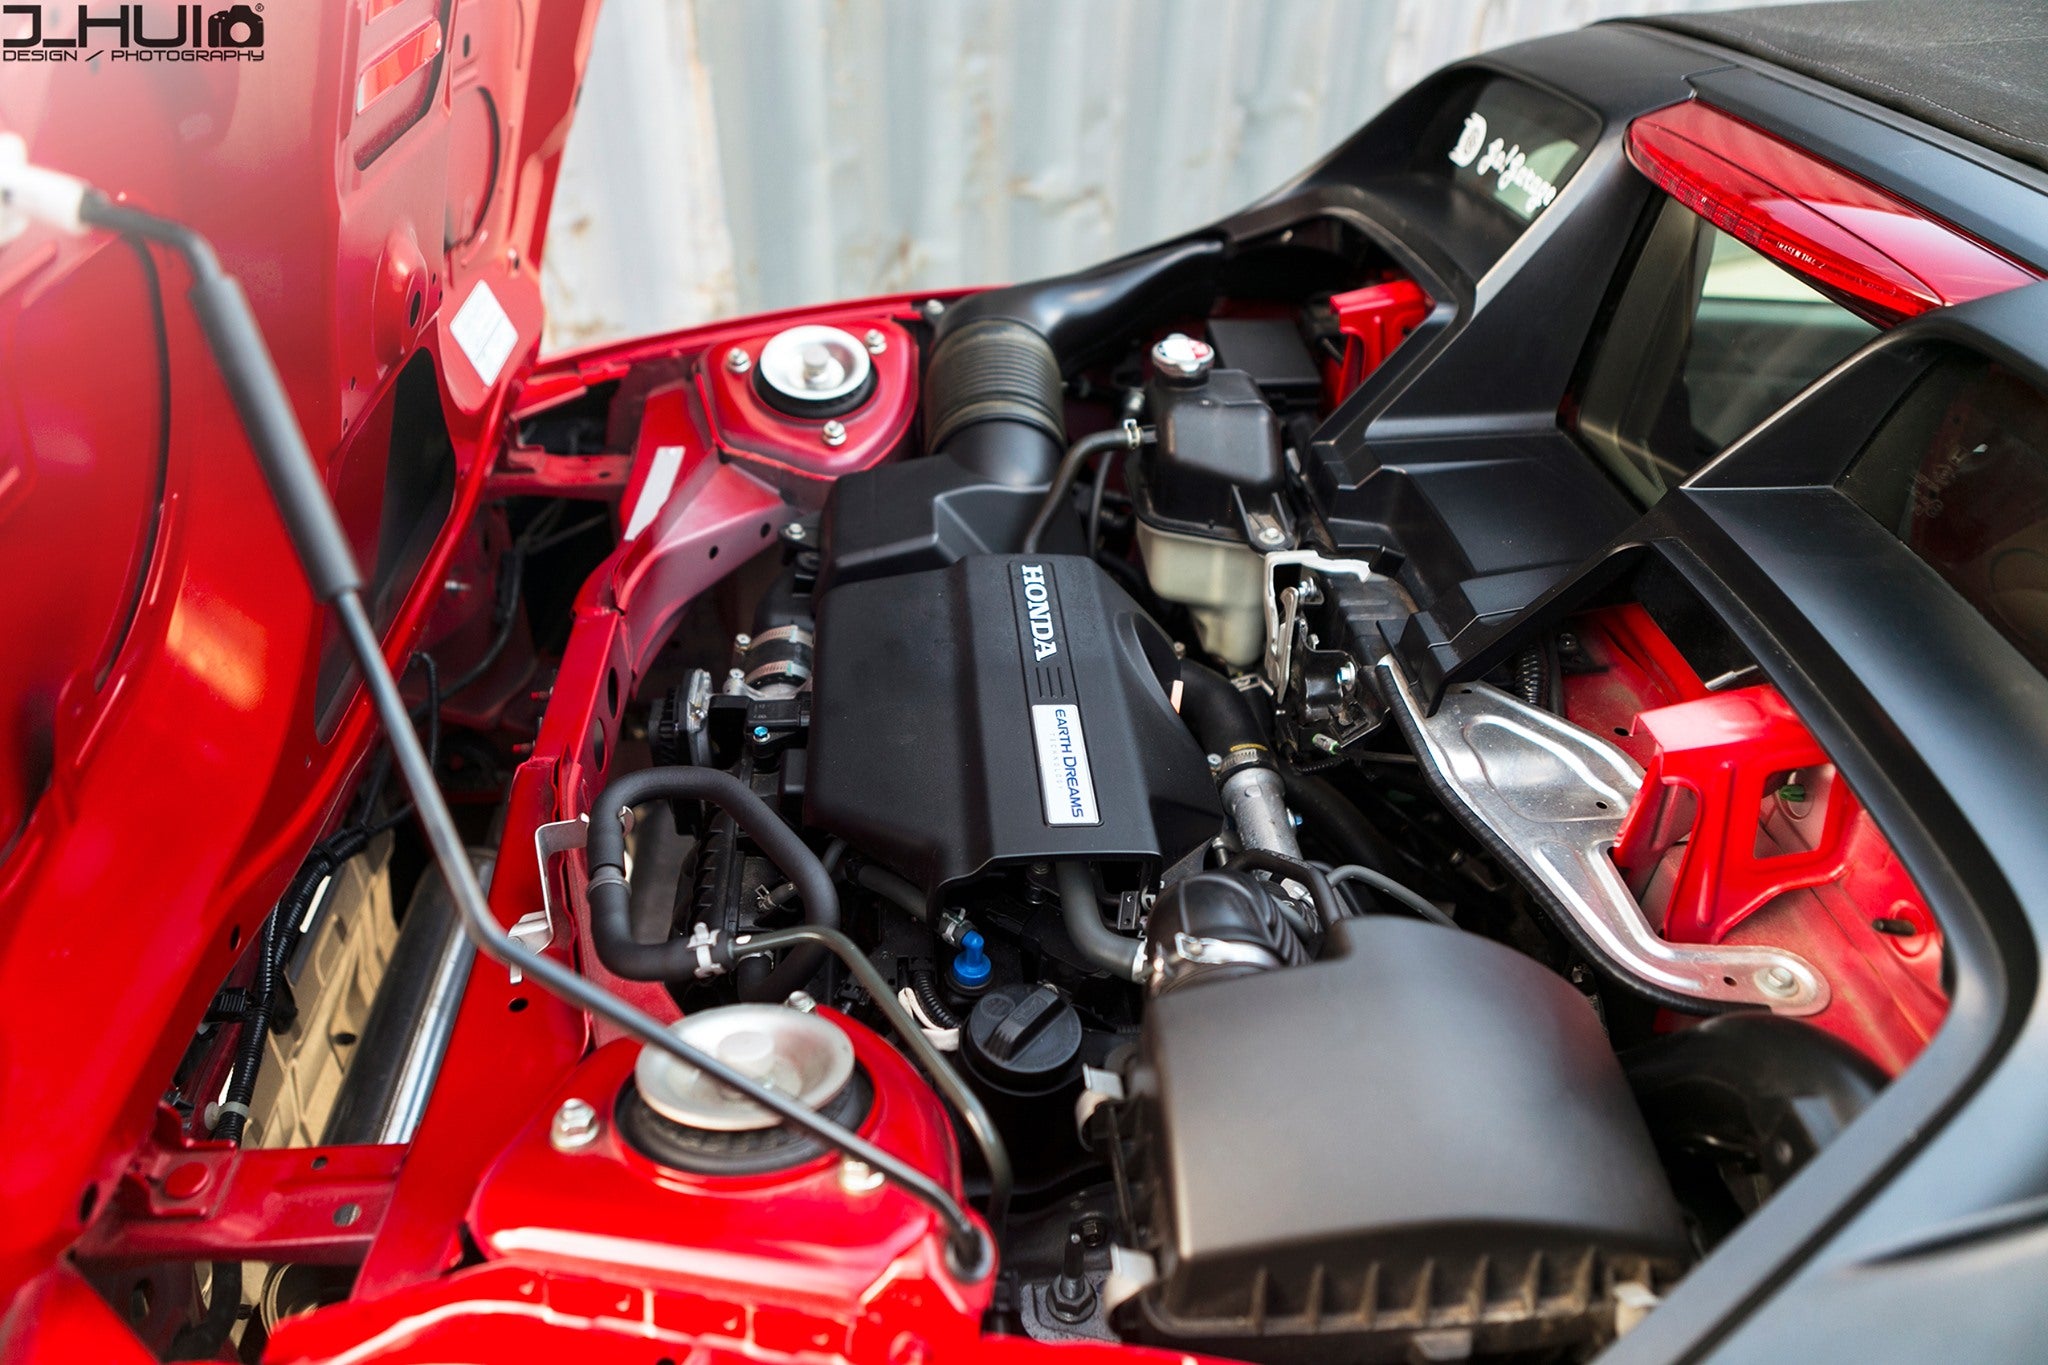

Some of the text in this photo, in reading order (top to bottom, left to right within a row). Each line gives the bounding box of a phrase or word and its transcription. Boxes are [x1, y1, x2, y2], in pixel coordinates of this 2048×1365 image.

[1021, 564, 1057, 662] HONDA
[1055, 708, 1084, 818] EARTH DREAMS
